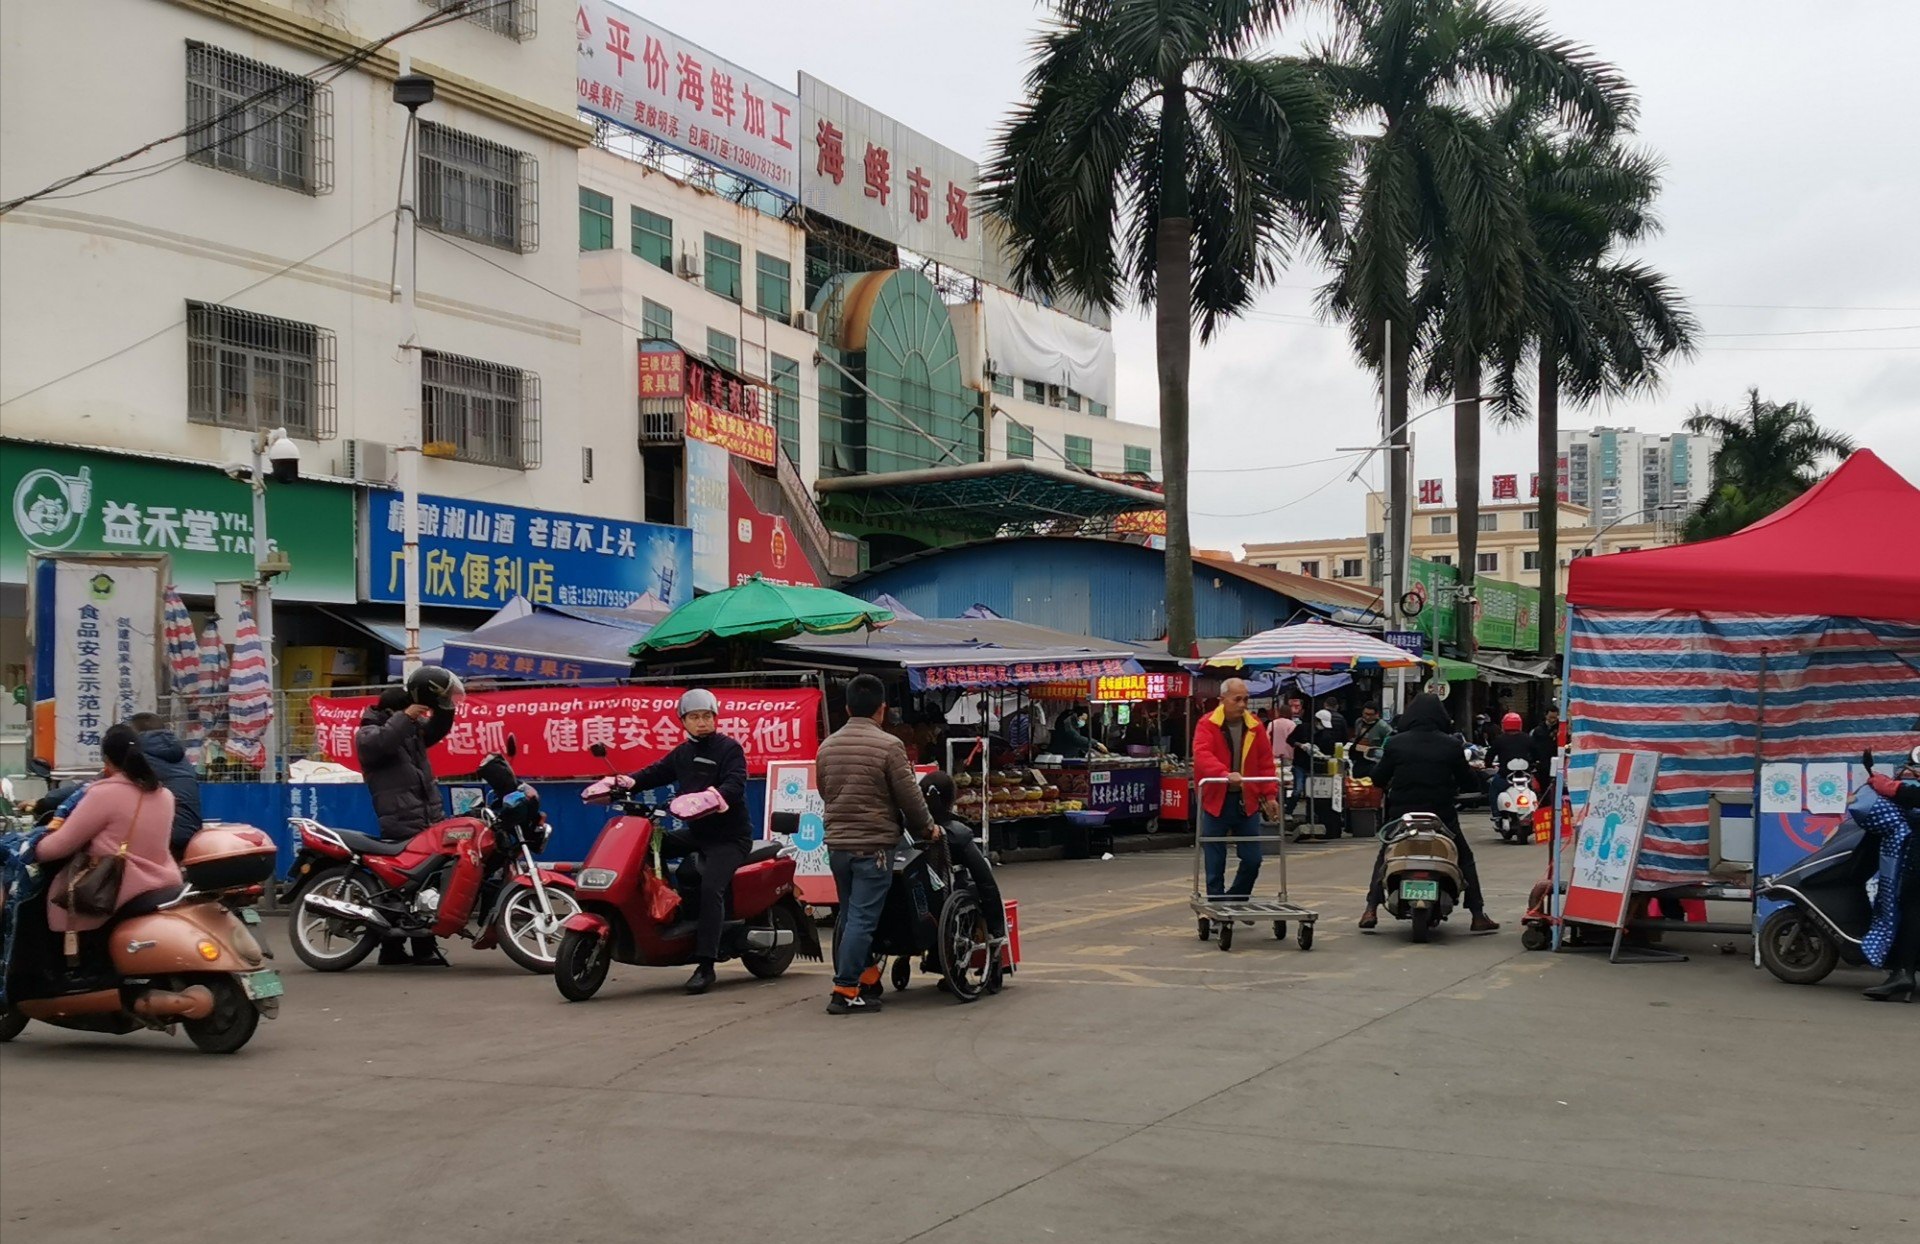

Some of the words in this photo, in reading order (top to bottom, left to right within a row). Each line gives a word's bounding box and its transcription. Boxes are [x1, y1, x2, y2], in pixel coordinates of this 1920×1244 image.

[576, 76, 624, 113] 0桌餐厅
[634, 100, 679, 138] 宽敞明亮
[606, 16, 792, 151] 平价海鲜加工
[816, 117, 969, 241] 海鲜市场
[102, 500, 220, 553] 益禾堂
[220, 511, 254, 532] YH.
[528, 516, 637, 559] 老酒不上头
[76, 603, 101, 746] 食品安全示范市场
[1166, 676, 1183, 693] 果汁
[471, 703, 492, 717] ca,
[496, 697, 584, 717] gengangh
[588, 696, 650, 714] mwngz
[724, 699, 801, 712] ancienz.
